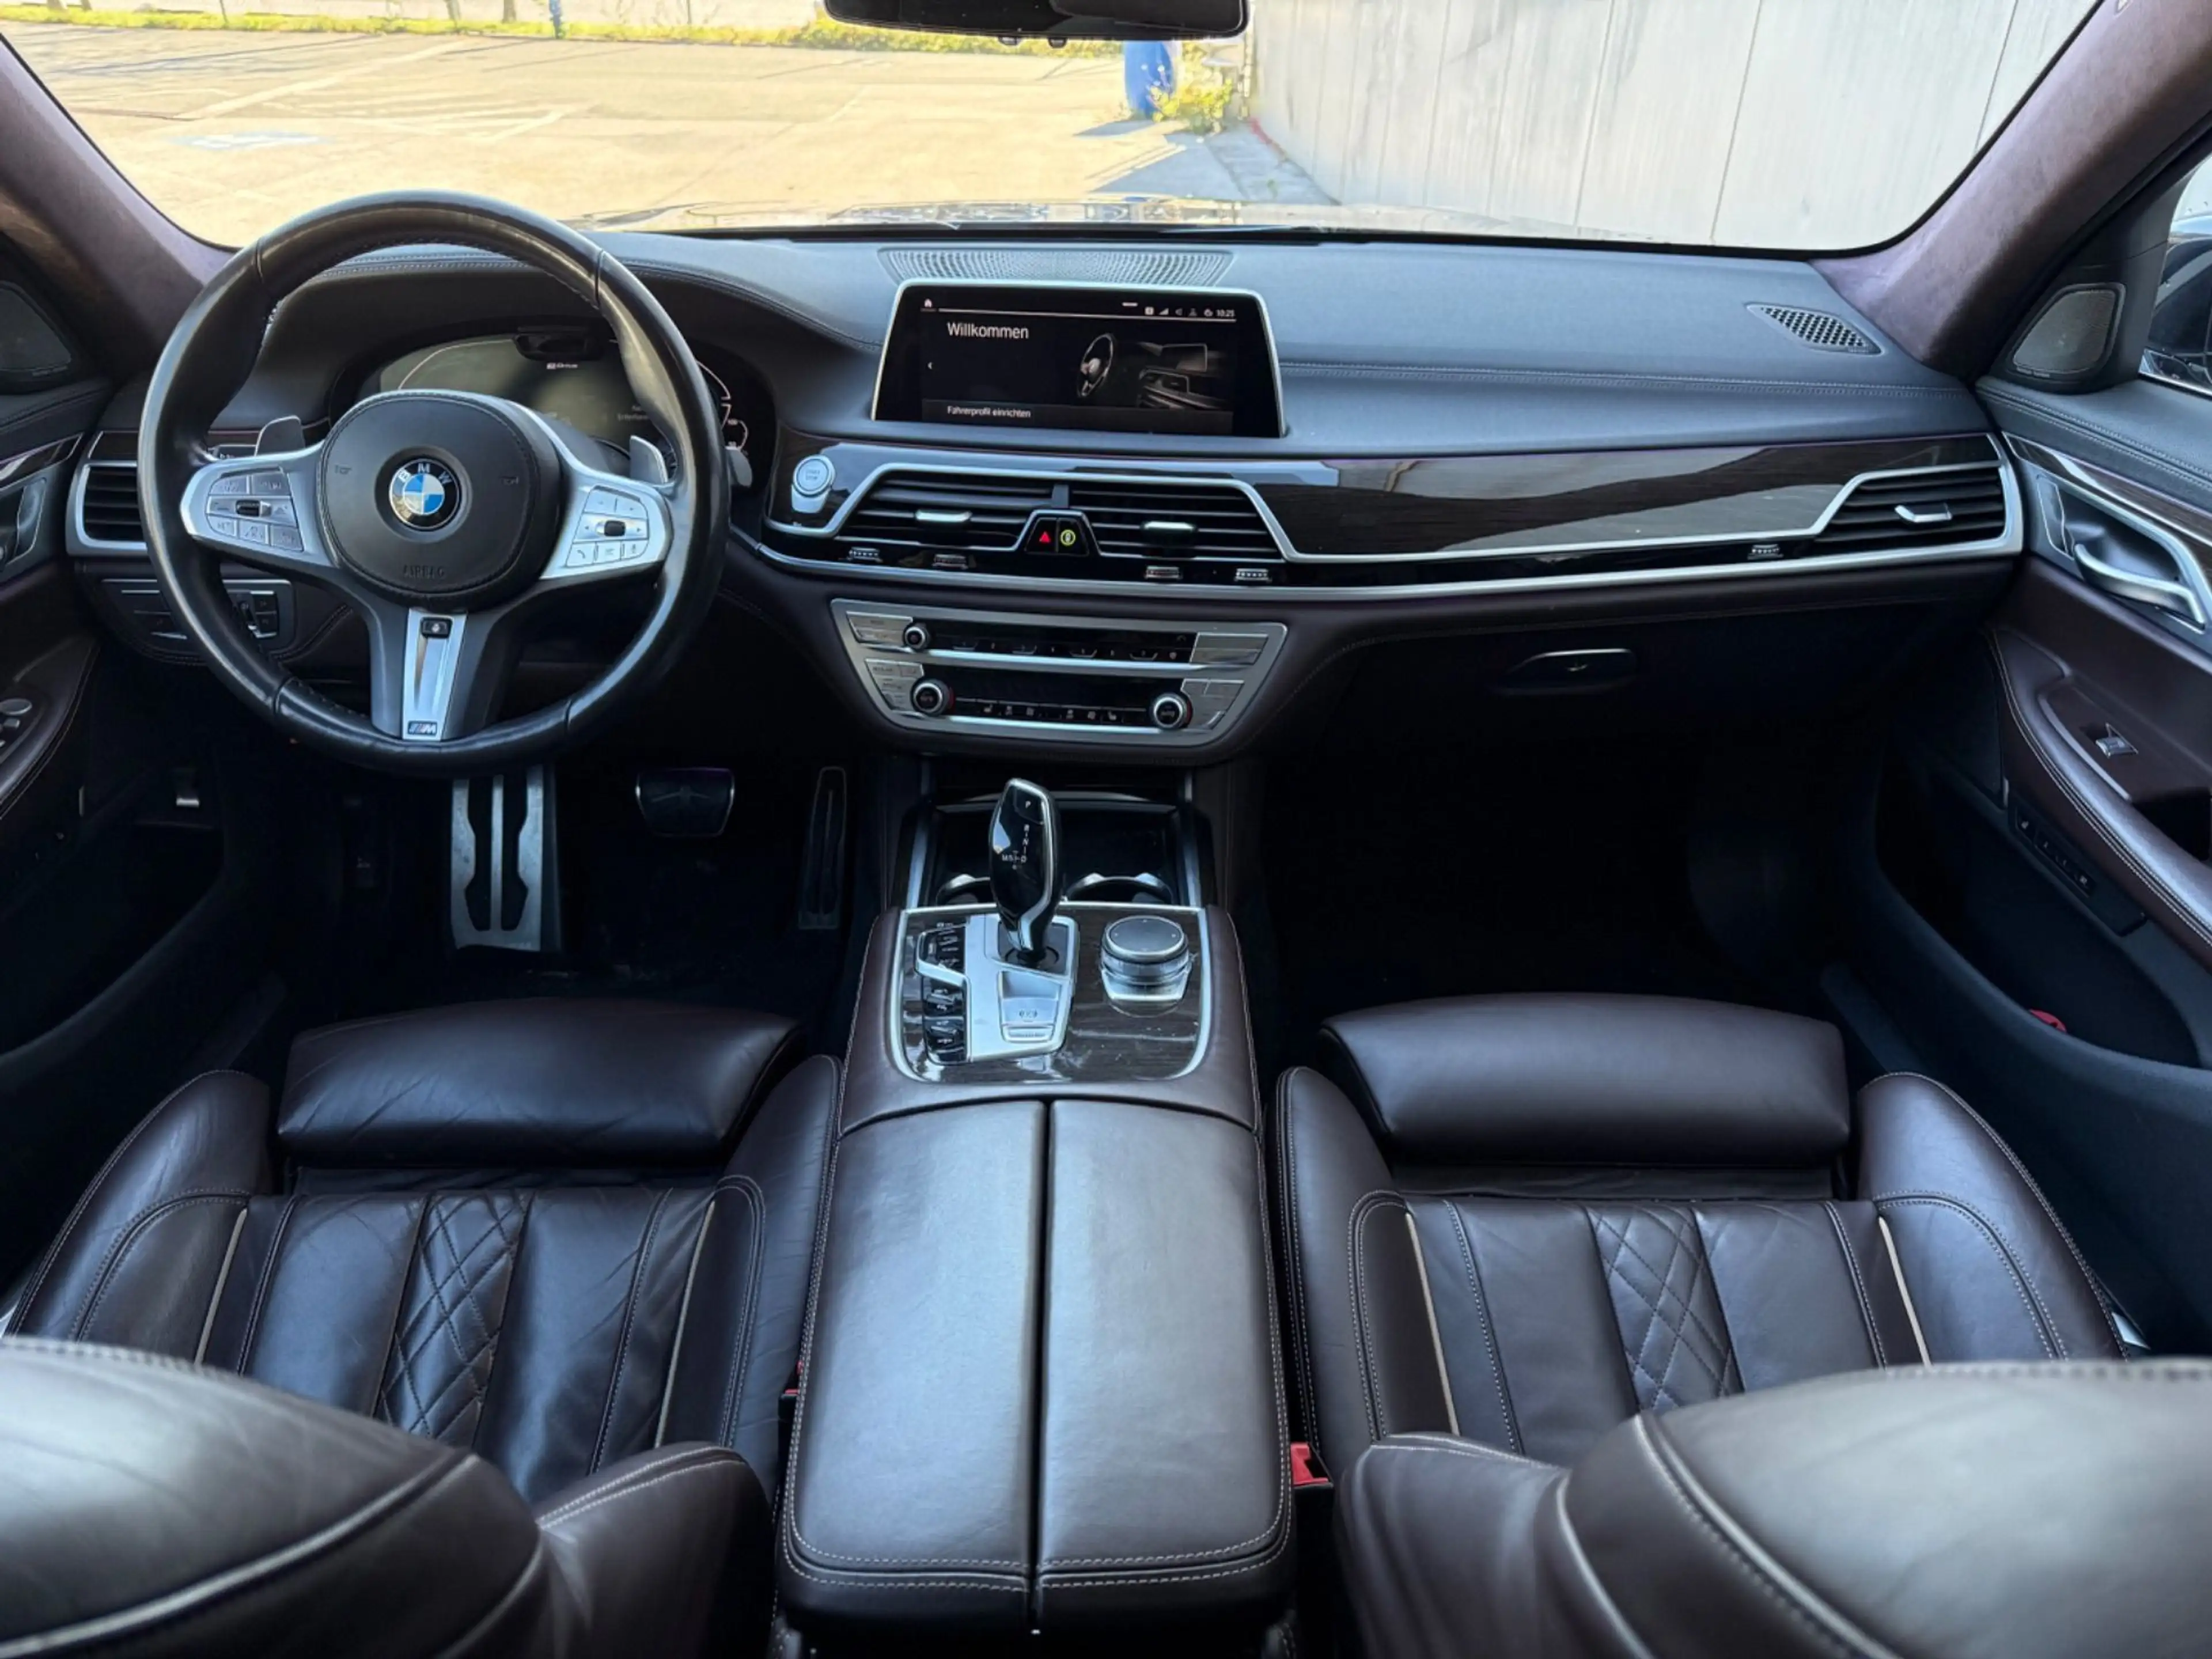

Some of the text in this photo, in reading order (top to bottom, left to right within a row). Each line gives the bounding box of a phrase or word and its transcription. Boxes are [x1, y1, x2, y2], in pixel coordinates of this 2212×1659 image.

[946, 321, 1029, 339] Willkommen
[947, 405, 1031, 418] Fahrerprofil einrichten
[397, 463, 453, 483] BMW
